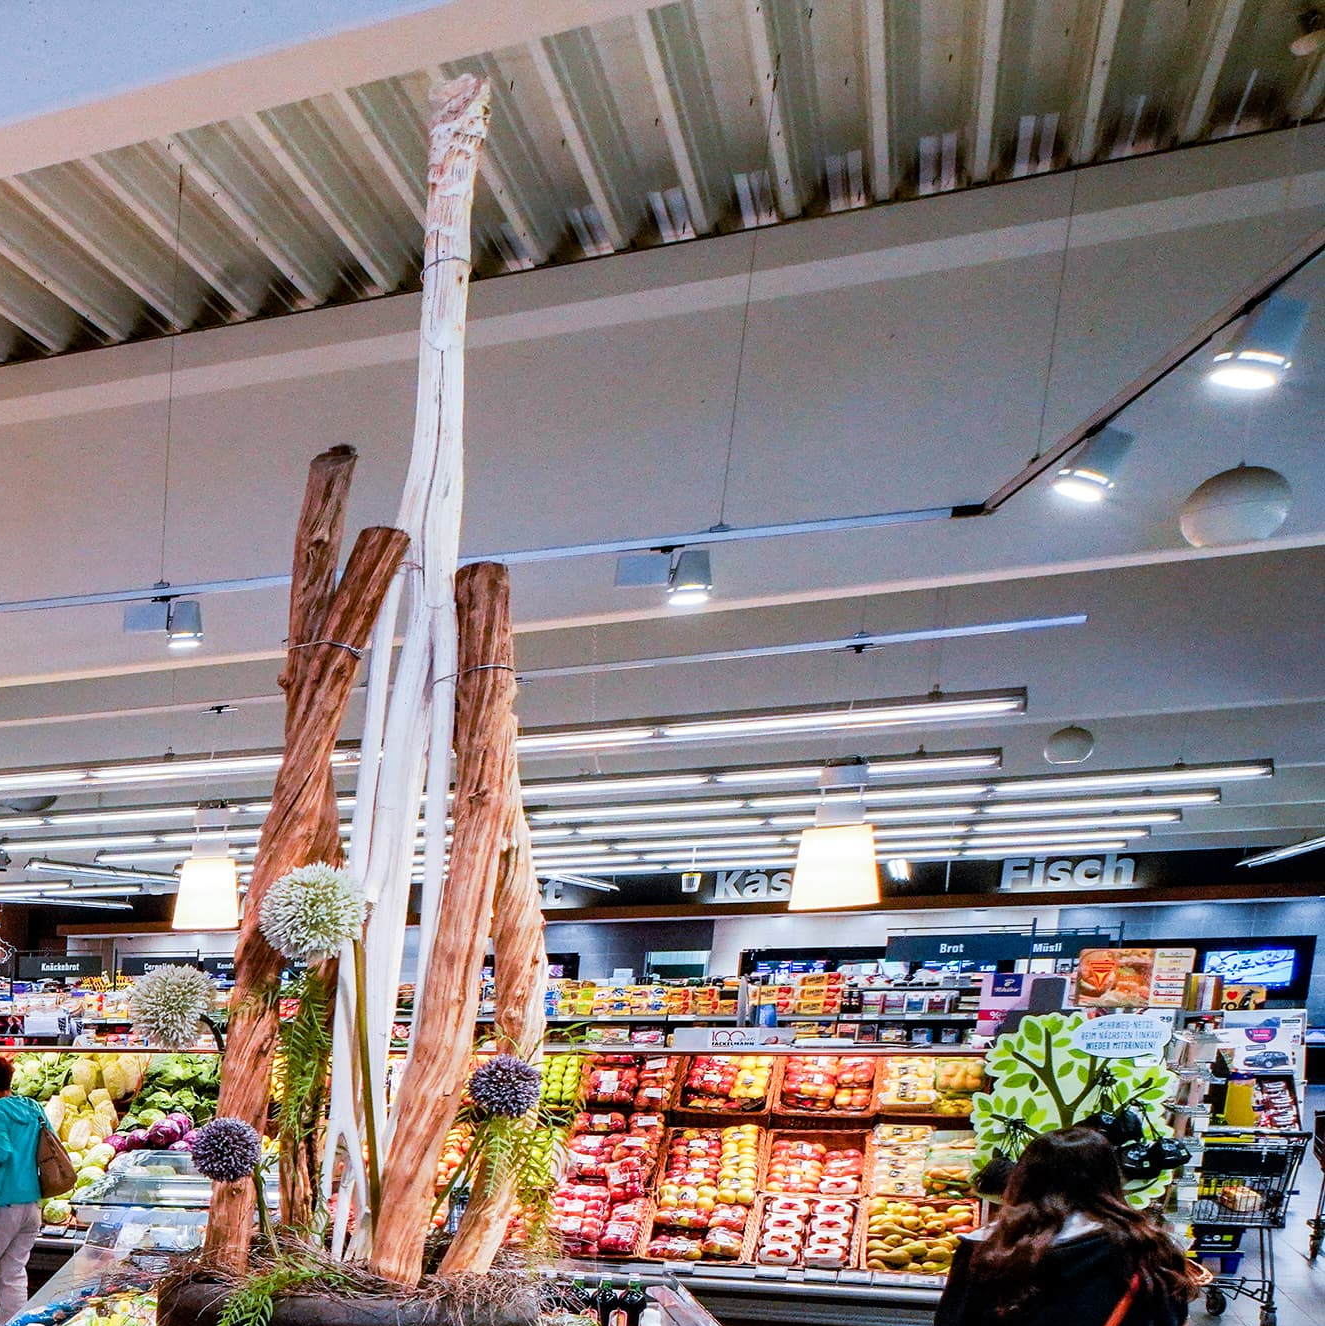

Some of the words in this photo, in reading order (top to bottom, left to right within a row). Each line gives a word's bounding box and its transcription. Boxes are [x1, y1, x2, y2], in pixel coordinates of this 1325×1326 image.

[1000, 853, 1136, 890] Fisch
[714, 868, 792, 899] Käs
[939, 943, 965, 954] Brot
[1032, 941, 1062, 953] Müsli
[41, 961, 80, 972] Knäckebrot
